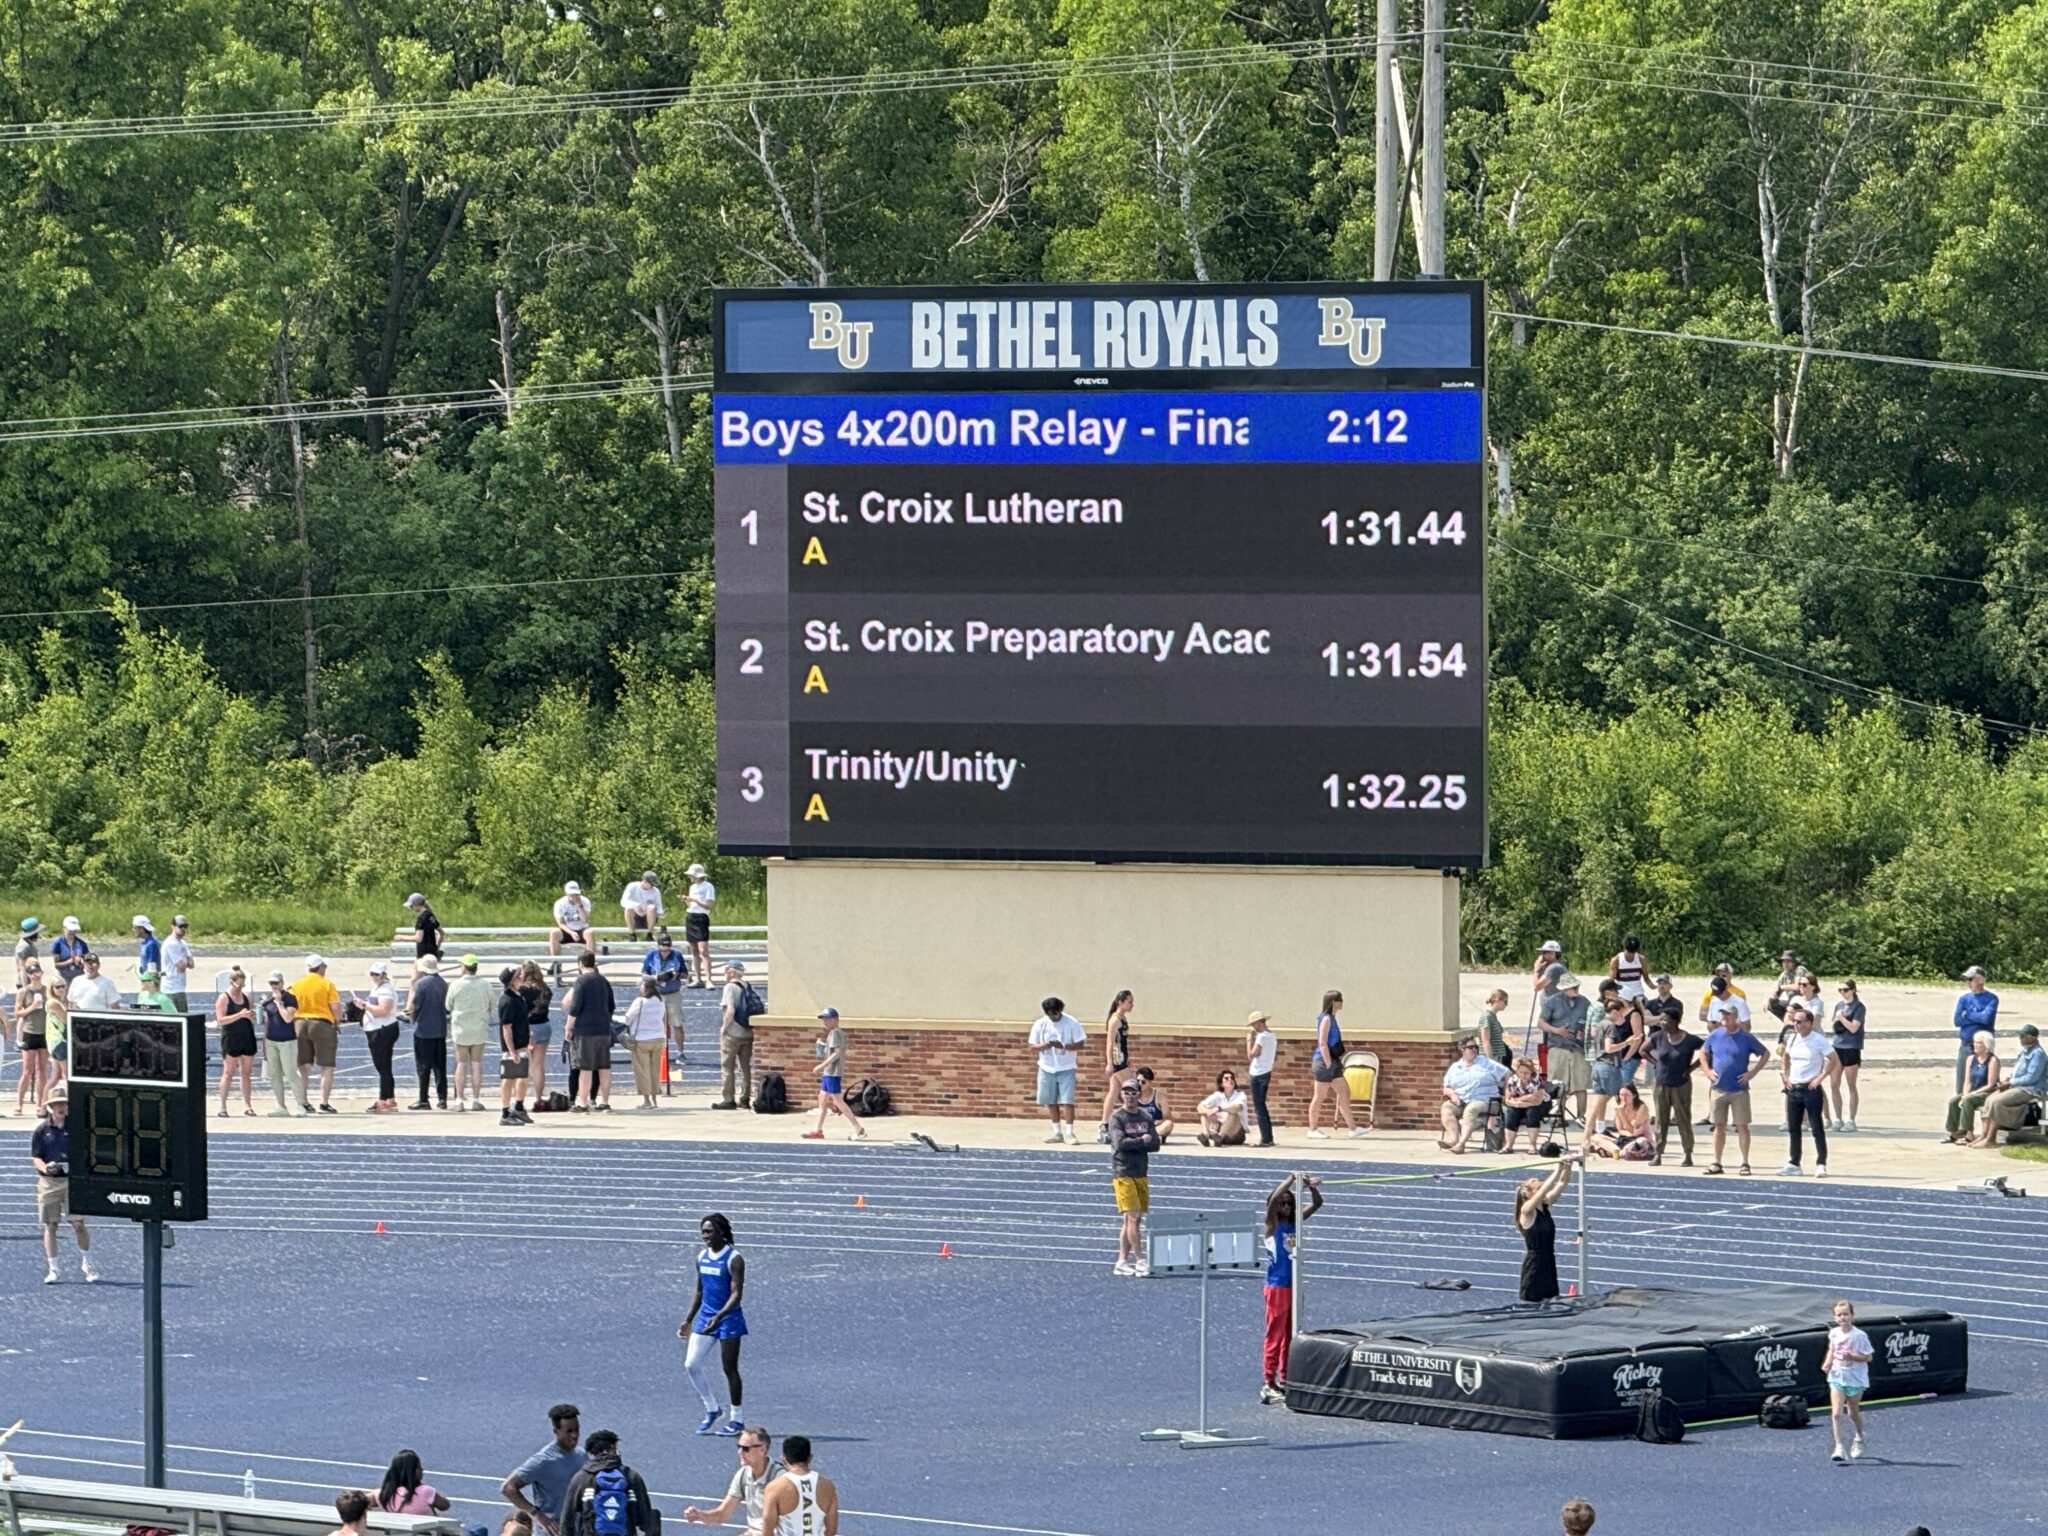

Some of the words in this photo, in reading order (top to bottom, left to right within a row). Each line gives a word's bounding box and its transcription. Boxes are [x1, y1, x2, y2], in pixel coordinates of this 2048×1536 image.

[809, 302, 873, 370] BU
[912, 301, 1081, 369] BETHEL
[1094, 298, 1278, 368] ROYALS
[1318, 298, 1386, 366] BU
[721, 410, 825, 457] Boys
[837, 409, 996, 447] 4x200m
[1010, 408, 1127, 455] Relay
[1141, 427, 1156, 437] -
[1326, 409, 1409, 444] 2:12
[802, 491, 849, 524] St.
[860, 490, 954, 524] Croix
[964, 492, 1123, 525] Lutheran
[740, 509, 759, 546] 1
[1321, 510, 1466, 546] 1:31.44
[802, 536, 828, 566] A
[739, 638, 764, 675] 2
[803, 620, 849, 652] St.
[861, 620, 954, 653] Croix
[966, 620, 1175, 662] Preparatory
[1321, 641, 1467, 678] 1:31.54
[803, 664, 829, 694] A
[740, 766, 764, 803] 3
[804, 748, 1016, 790] Trinity/Unity
[804, 793, 830, 822] A
[1322, 773, 1468, 810] 1:32.25
[1352, 1350, 1390, 1365] BETHEL
[1391, 1354, 1453, 1372] UNIVERSITY
[1370, 1369, 1396, 1383] Track
[1397, 1372, 1408, 1385] &
[1409, 1374, 1433, 1388] Field
[1612, 1362, 1663, 1391] Richey
